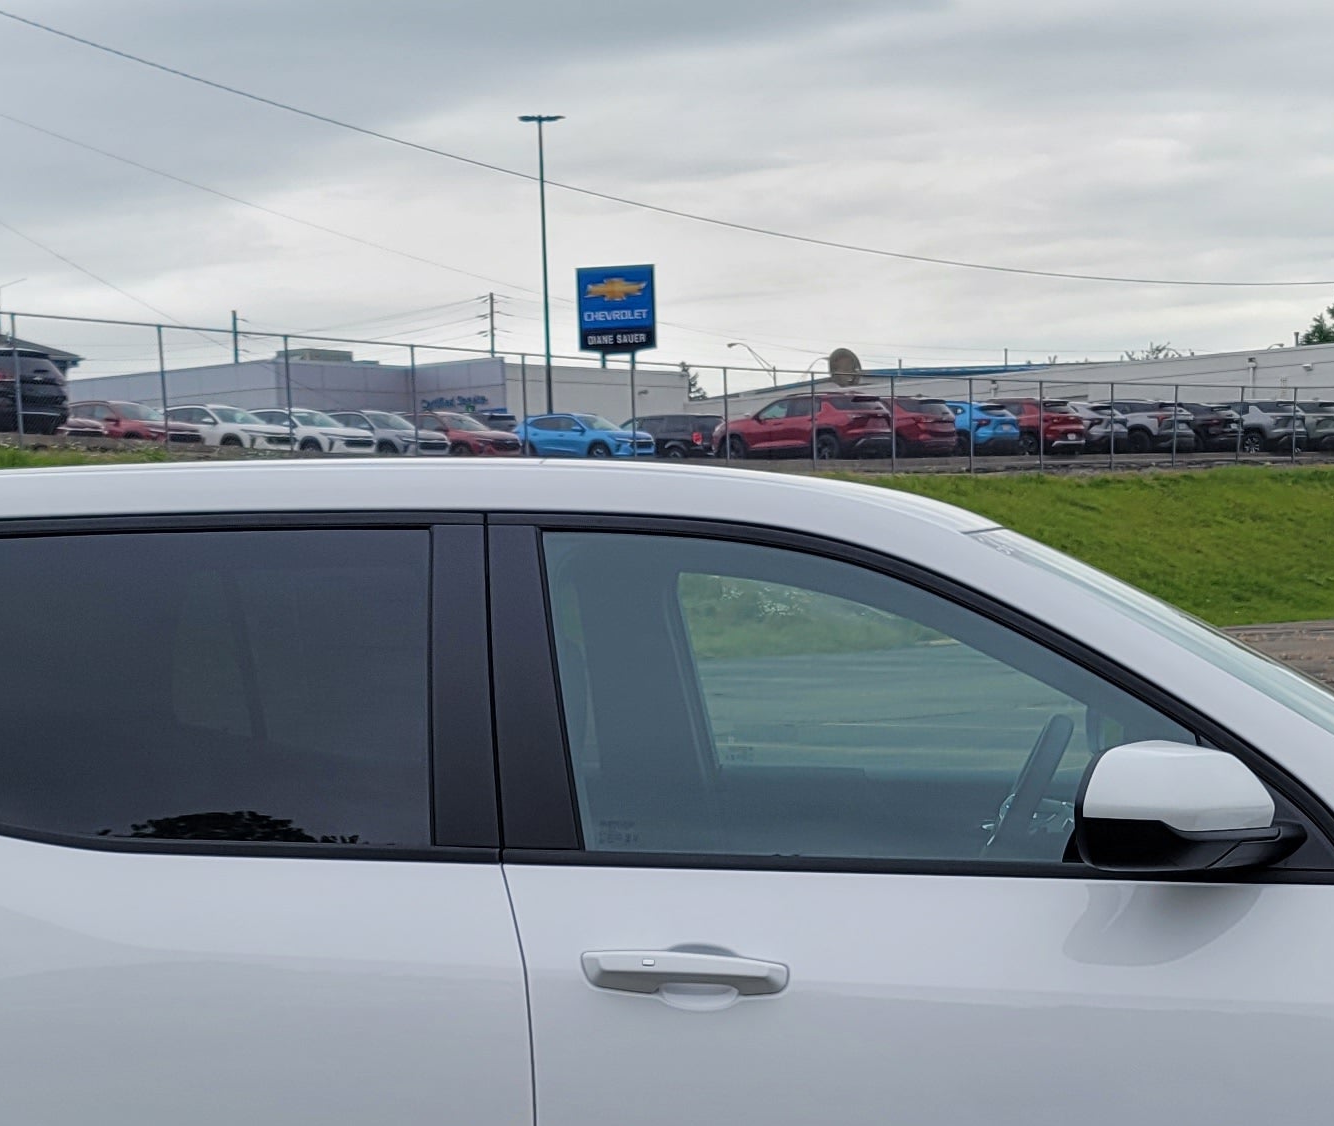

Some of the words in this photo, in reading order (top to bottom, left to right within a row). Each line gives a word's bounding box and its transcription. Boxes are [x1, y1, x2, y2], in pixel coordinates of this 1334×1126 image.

[584, 309, 648, 321] CHEVROLET
[587, 334, 614, 345] DIANE
[616, 333, 646, 344] SAUER
